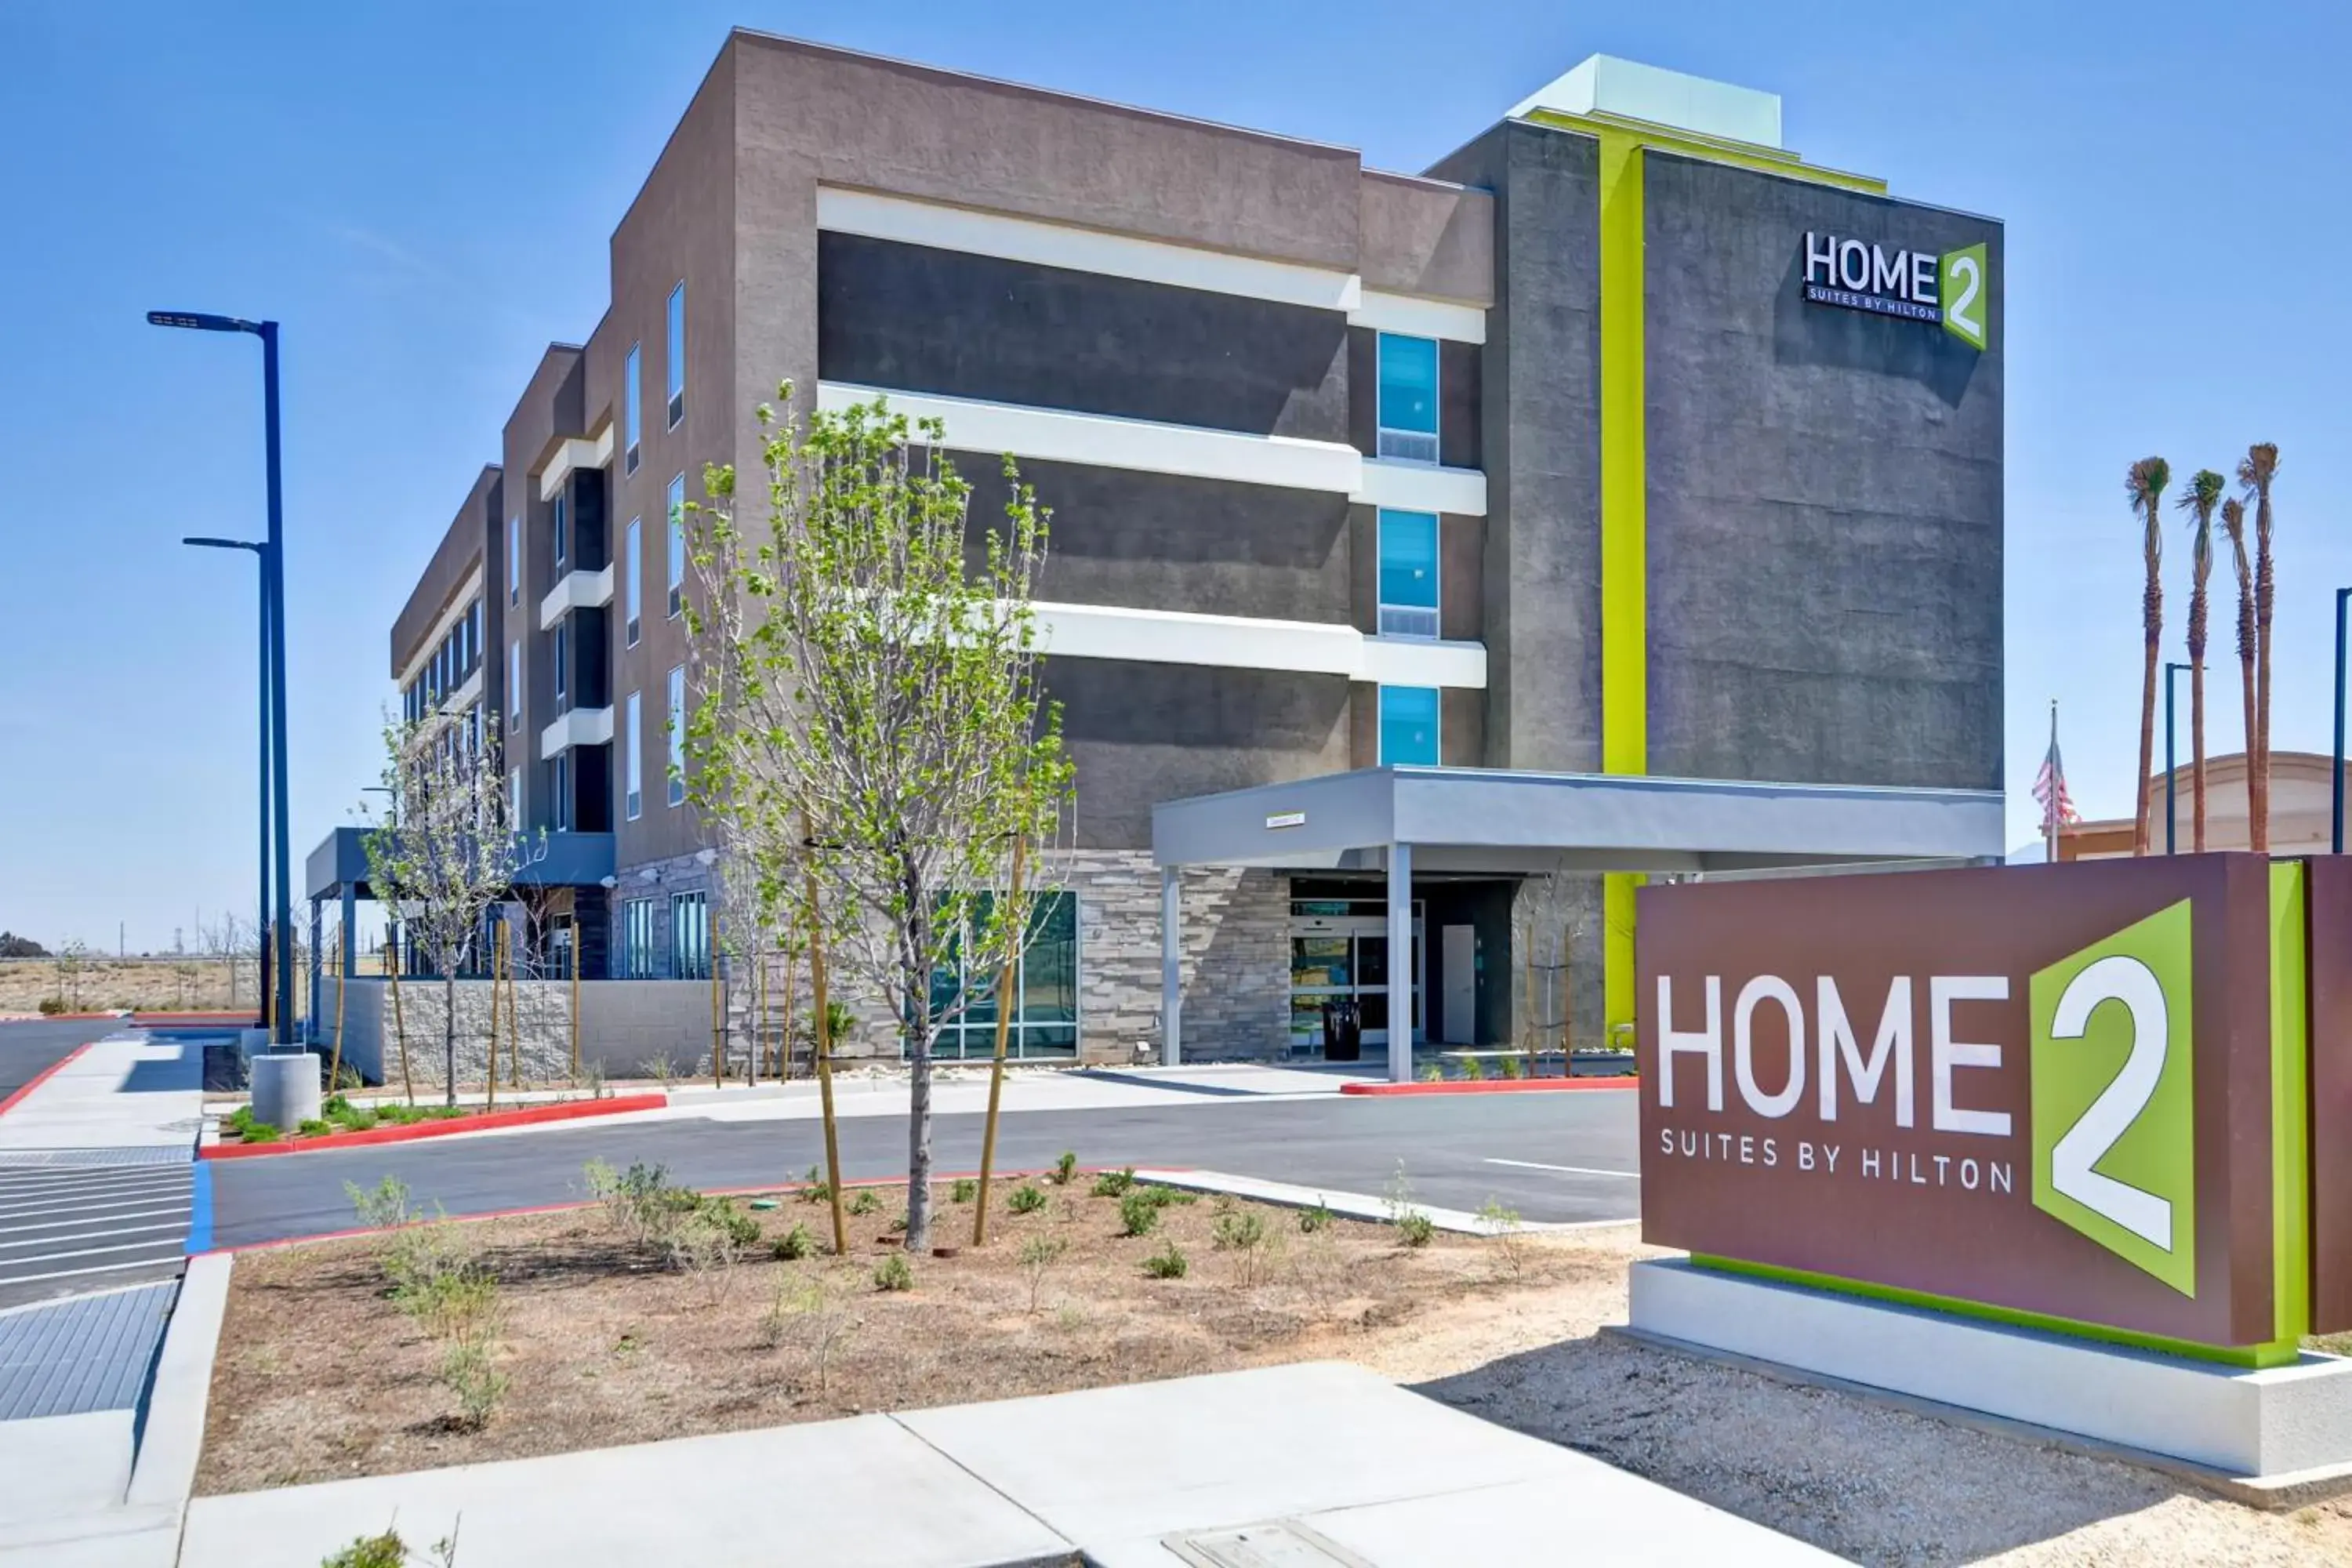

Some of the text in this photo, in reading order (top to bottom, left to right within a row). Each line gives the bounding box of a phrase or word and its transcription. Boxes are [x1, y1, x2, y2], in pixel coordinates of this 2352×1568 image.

[1806, 231, 1980, 337] HOME 2
[1809, 288, 1936, 320] SUITES BY HILTON
[1657, 954, 2173, 1254] HOME 2
[1661, 1128, 2012, 1193] SUITES BY HILTON
